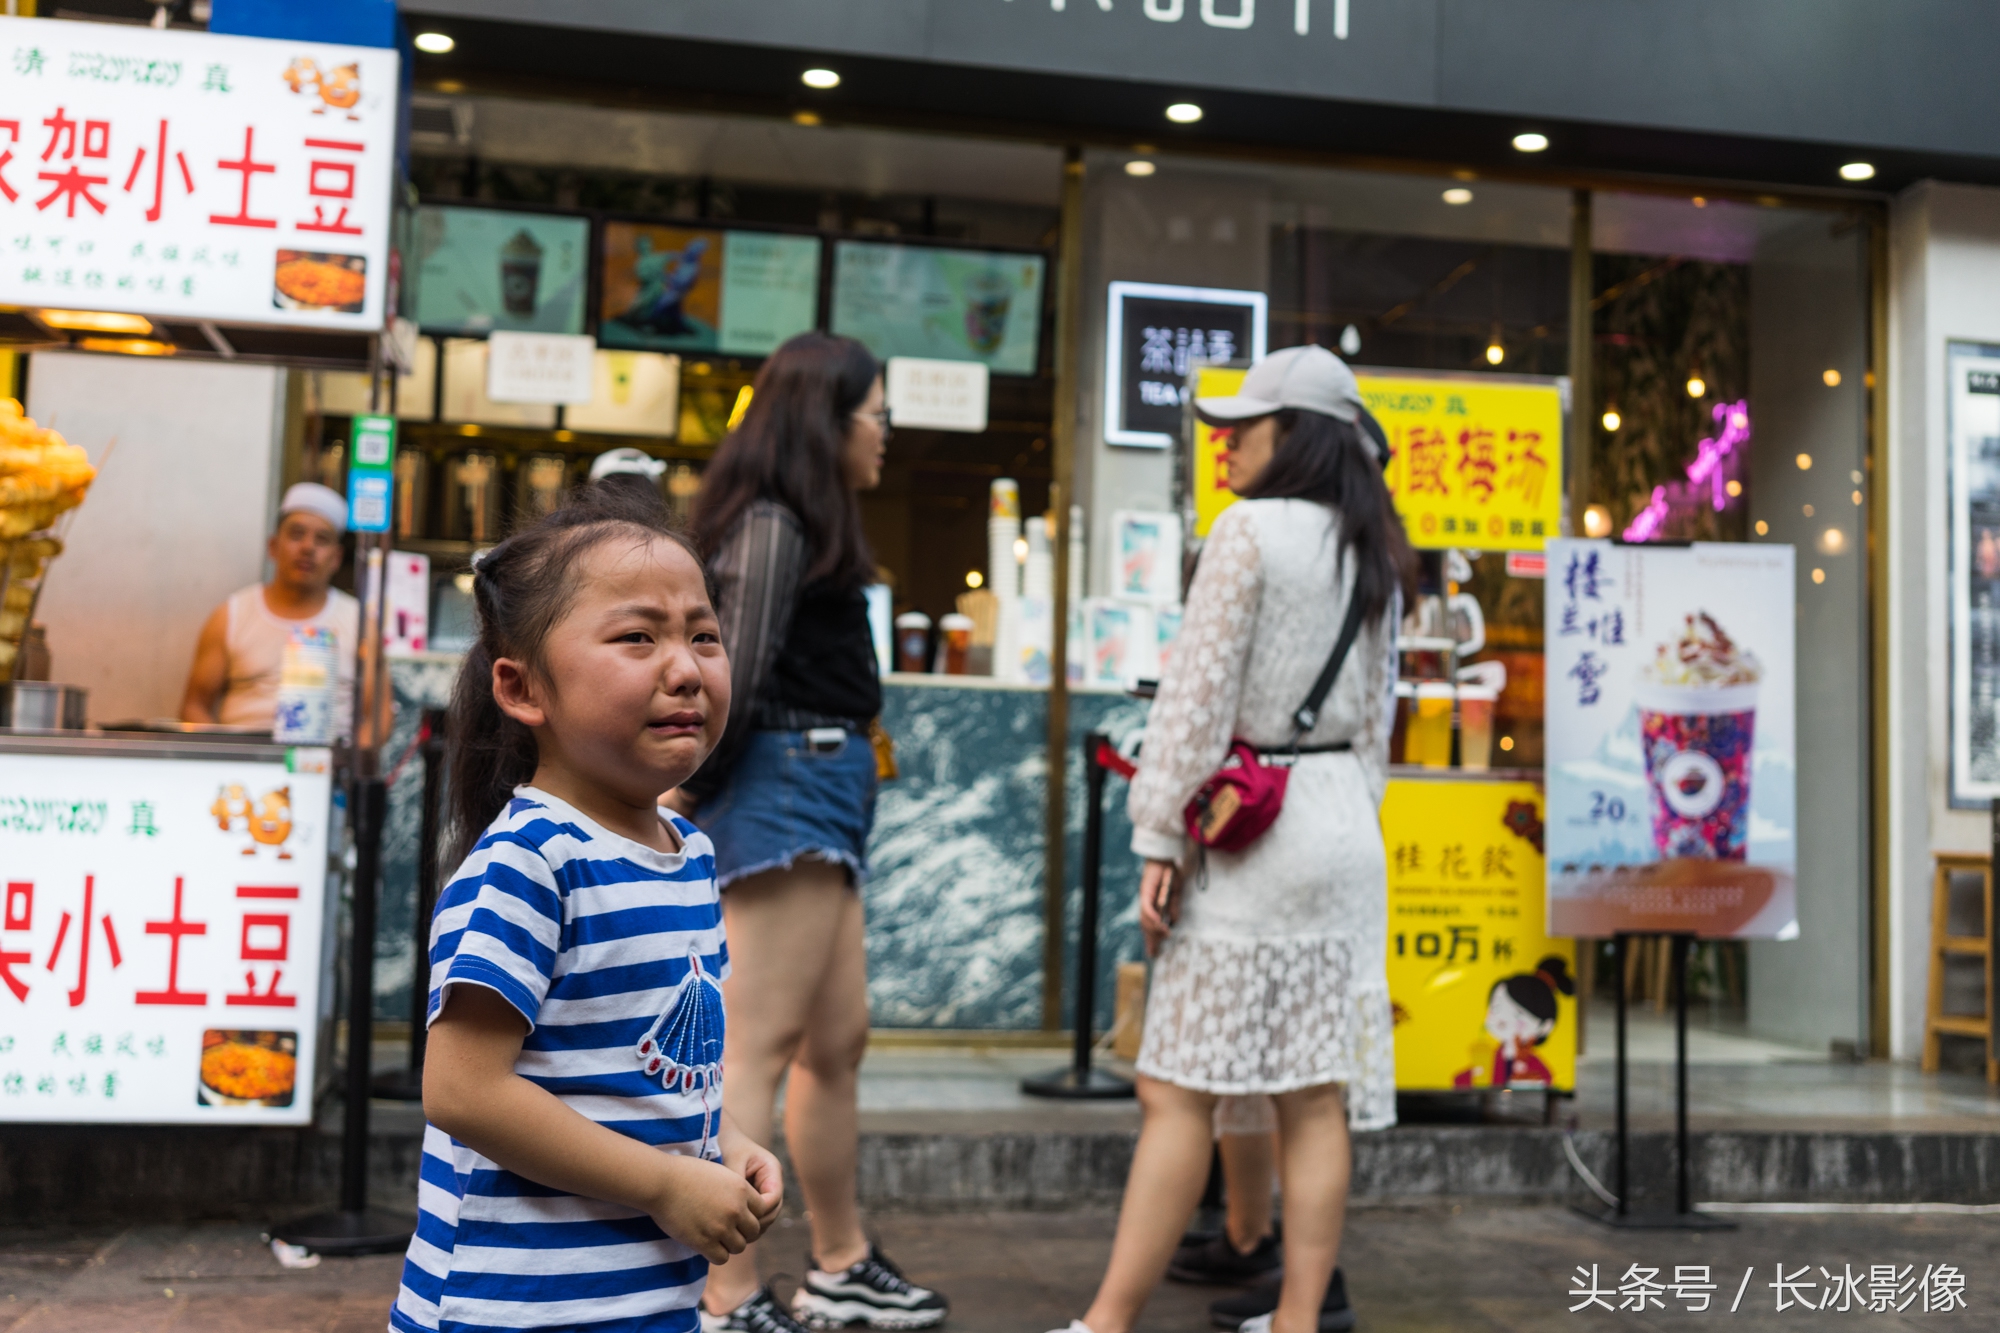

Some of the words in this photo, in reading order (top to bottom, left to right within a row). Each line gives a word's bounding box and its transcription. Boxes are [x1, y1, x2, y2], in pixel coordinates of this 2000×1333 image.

[14, 46, 49, 76] 清
[201, 63, 234, 93] 真
[0, 106, 366, 236] 架小土豆
[1389, 424, 1550, 512] 酸梅汤
[126, 799, 162, 837] 真
